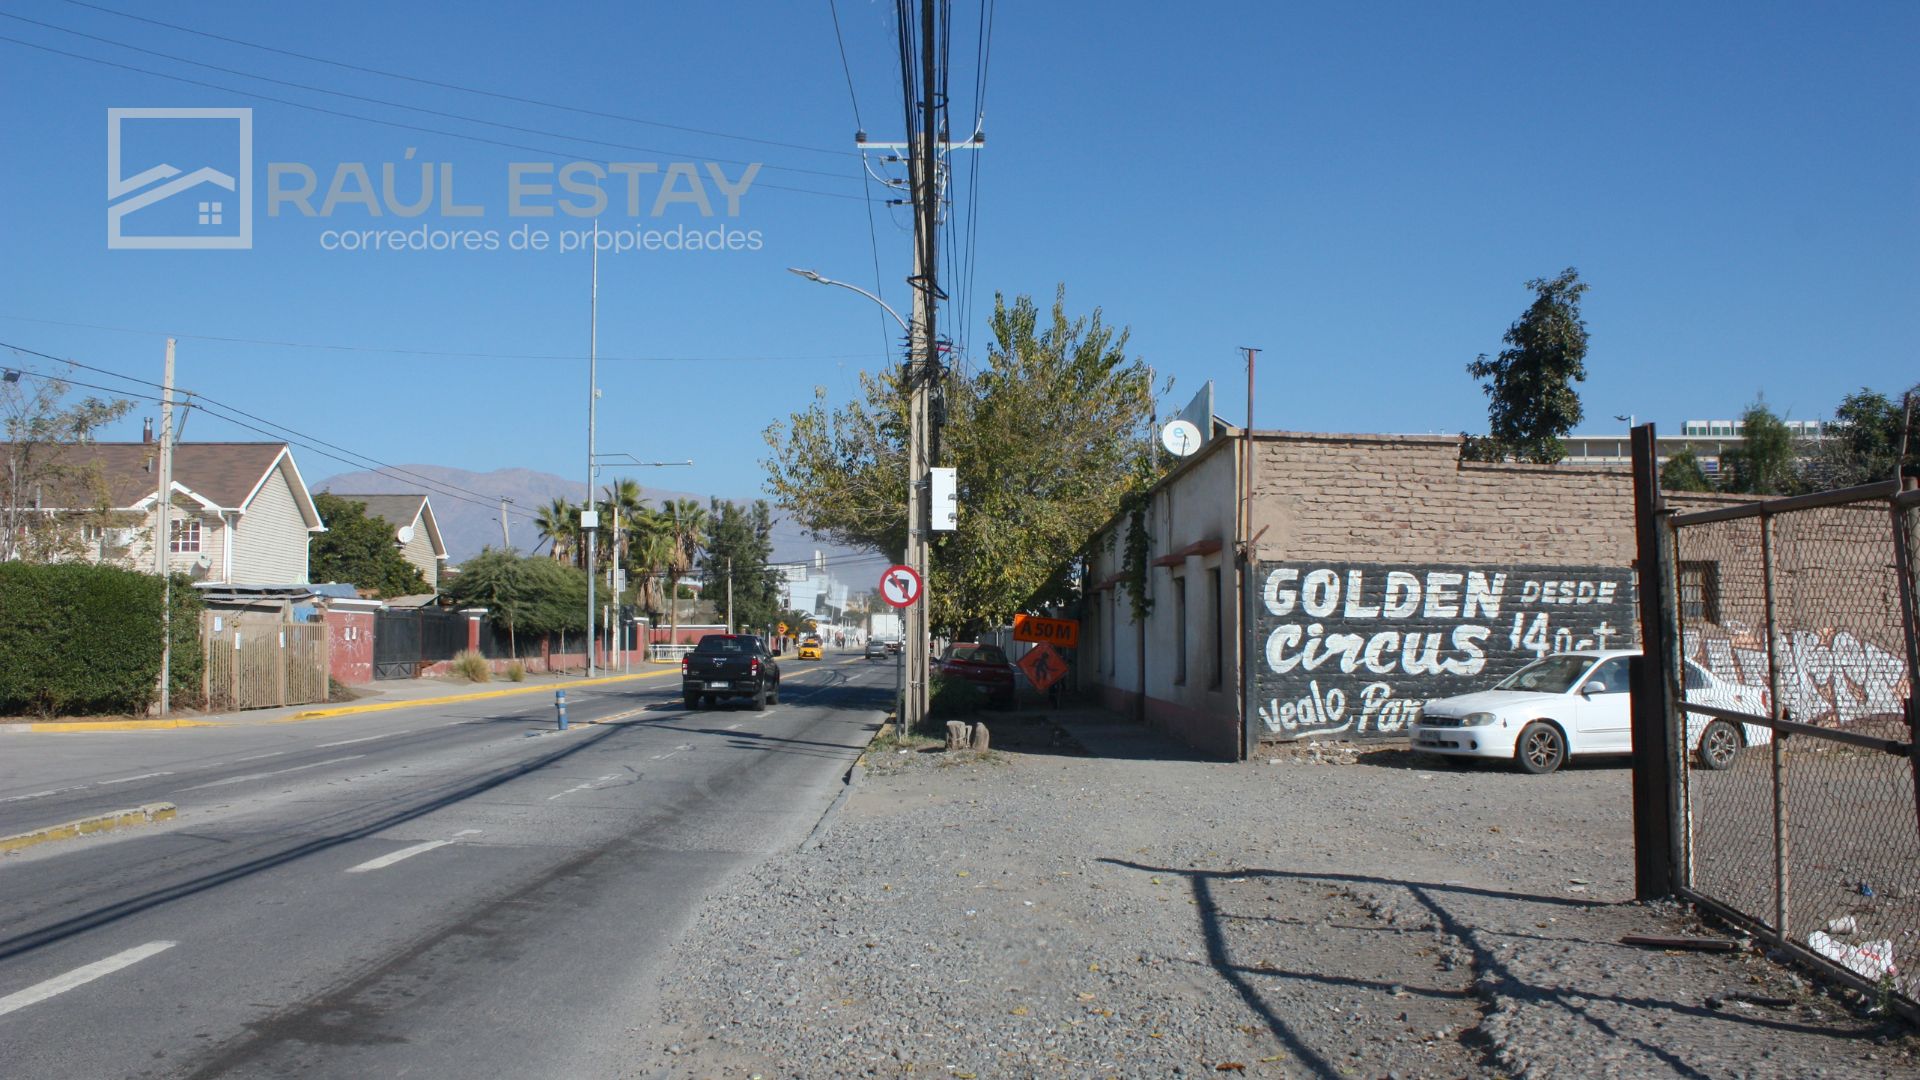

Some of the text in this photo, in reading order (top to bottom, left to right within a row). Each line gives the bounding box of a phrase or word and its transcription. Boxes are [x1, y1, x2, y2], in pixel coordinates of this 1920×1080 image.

[1264, 568, 1507, 618] GOLDEN
[1520, 580, 1617, 604] DESDE
[1021, 621, 1032, 635] A
